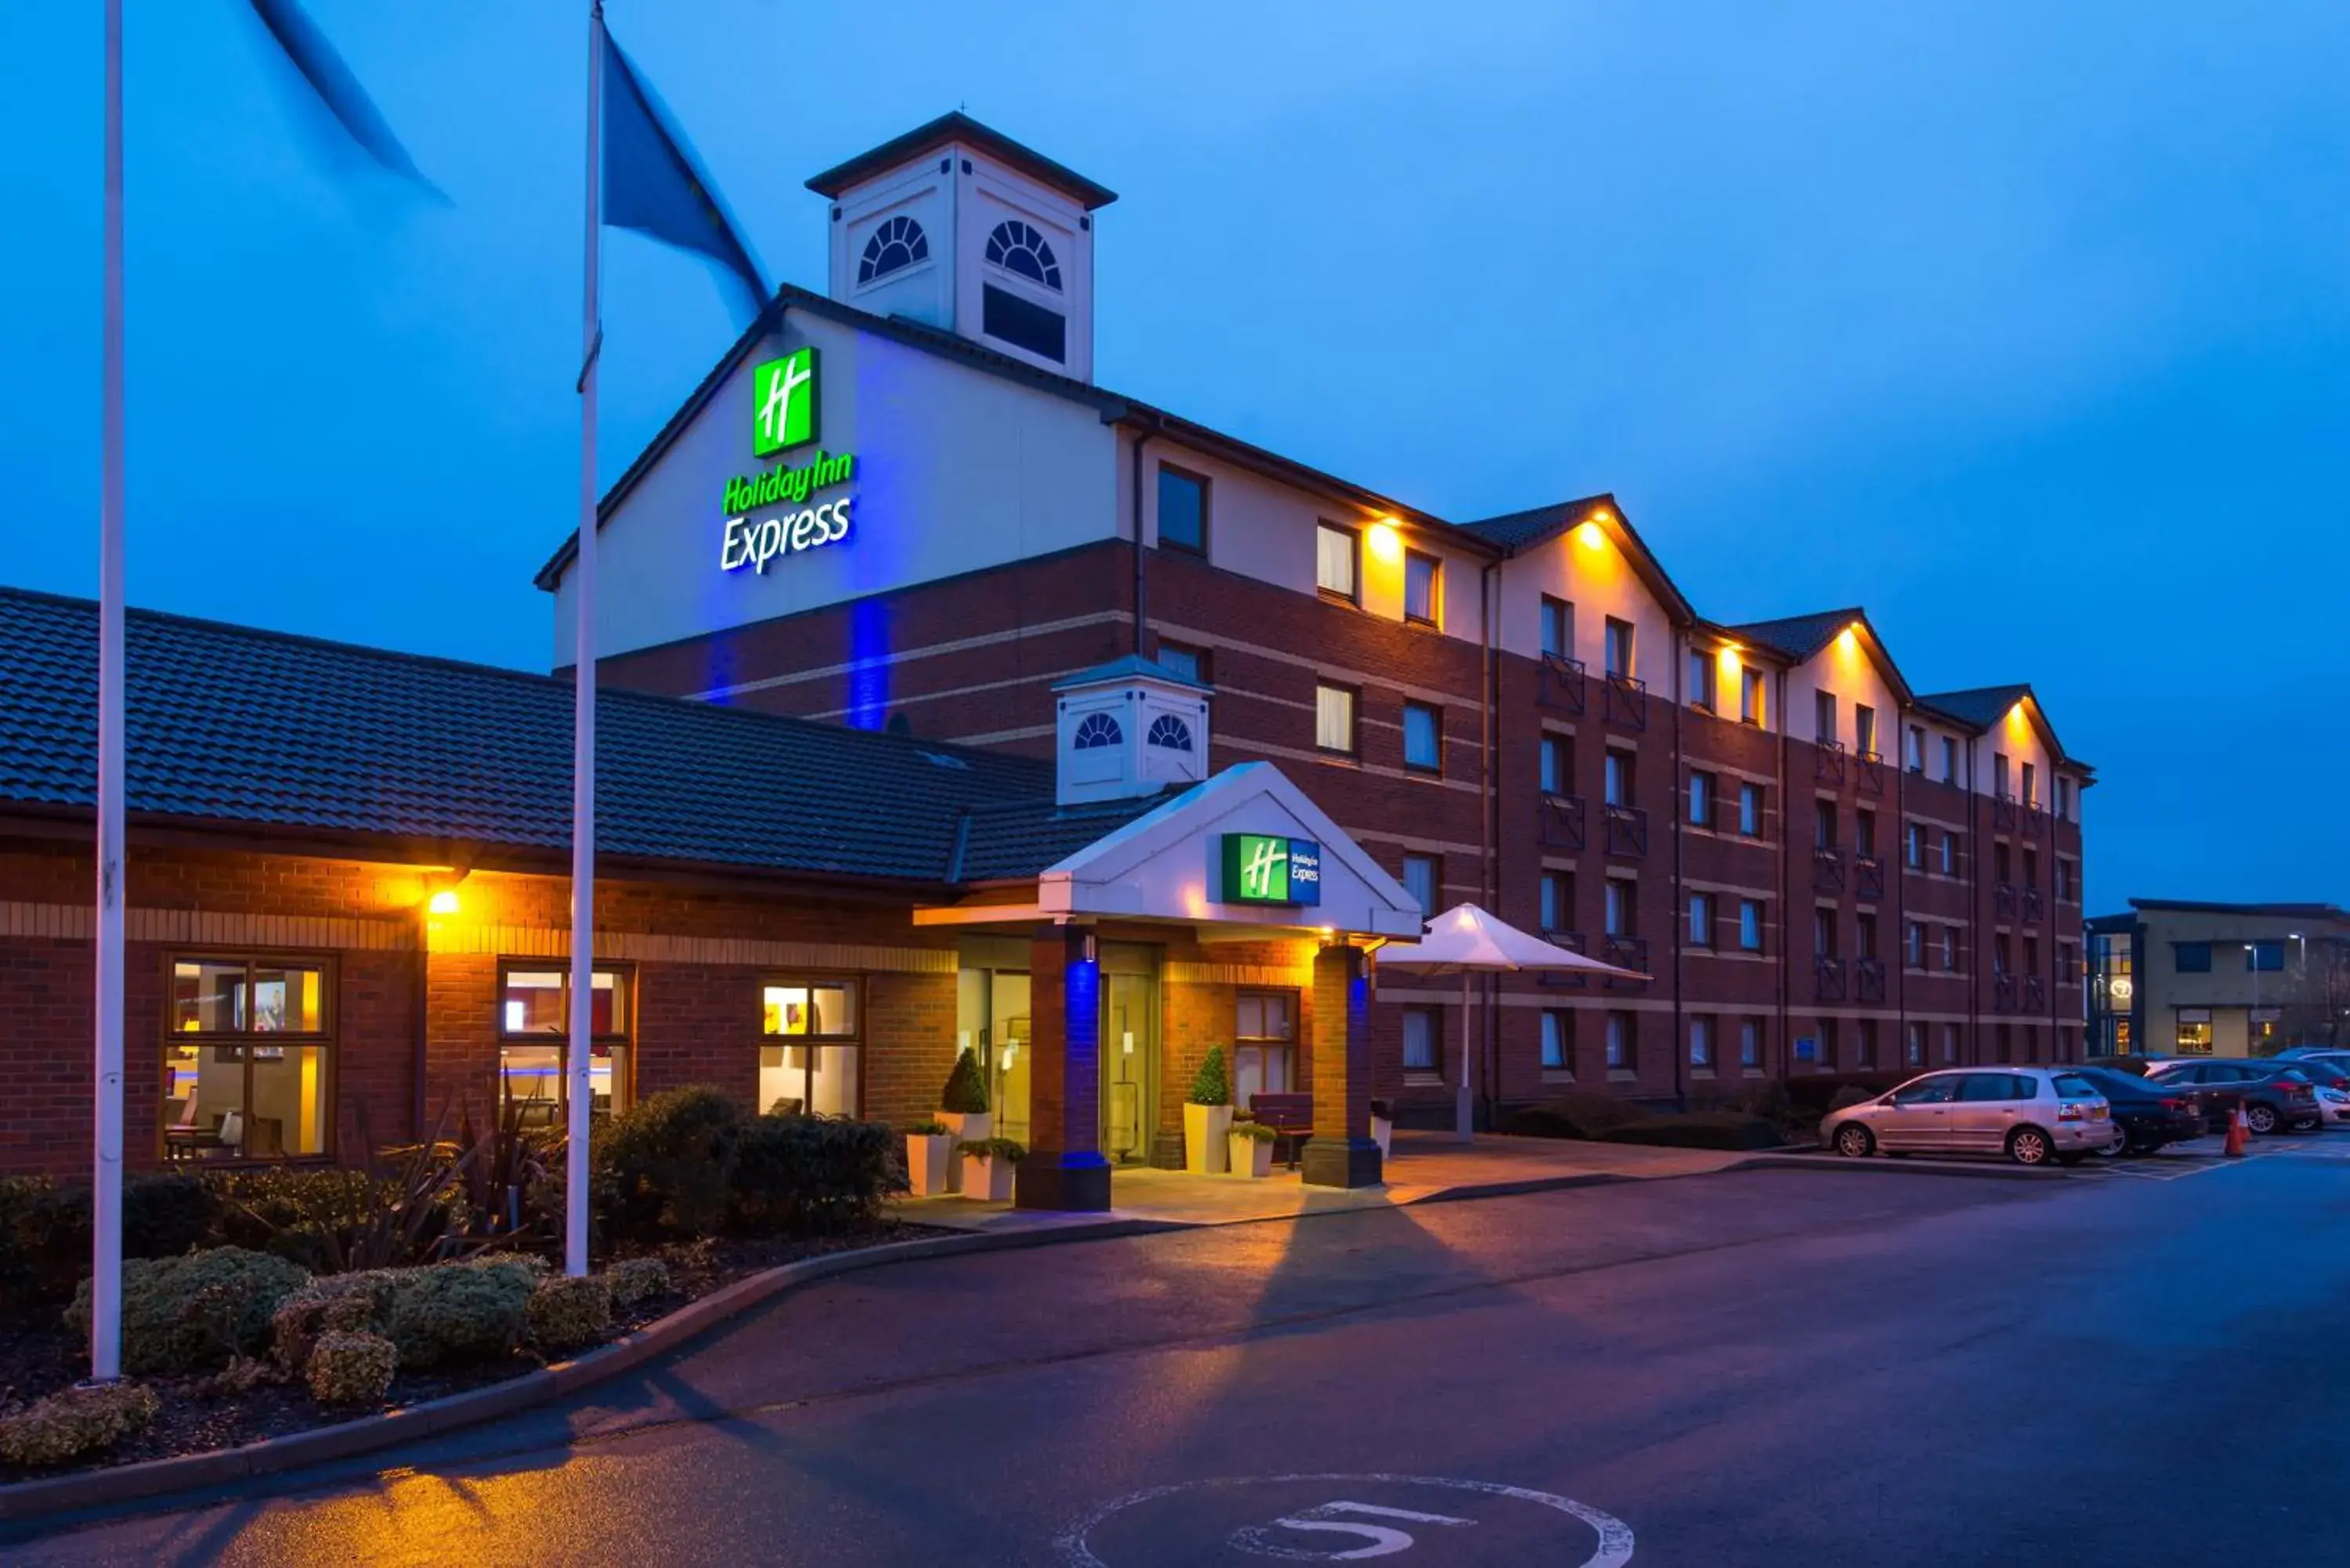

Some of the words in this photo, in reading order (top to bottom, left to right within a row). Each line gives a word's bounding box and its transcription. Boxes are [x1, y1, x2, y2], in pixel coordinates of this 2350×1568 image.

[757, 357, 811, 443] H
[723, 463, 812, 515] Holiday
[812, 450, 852, 488] Inn
[721, 498, 851, 575] Express
[1244, 840, 1287, 895] H
